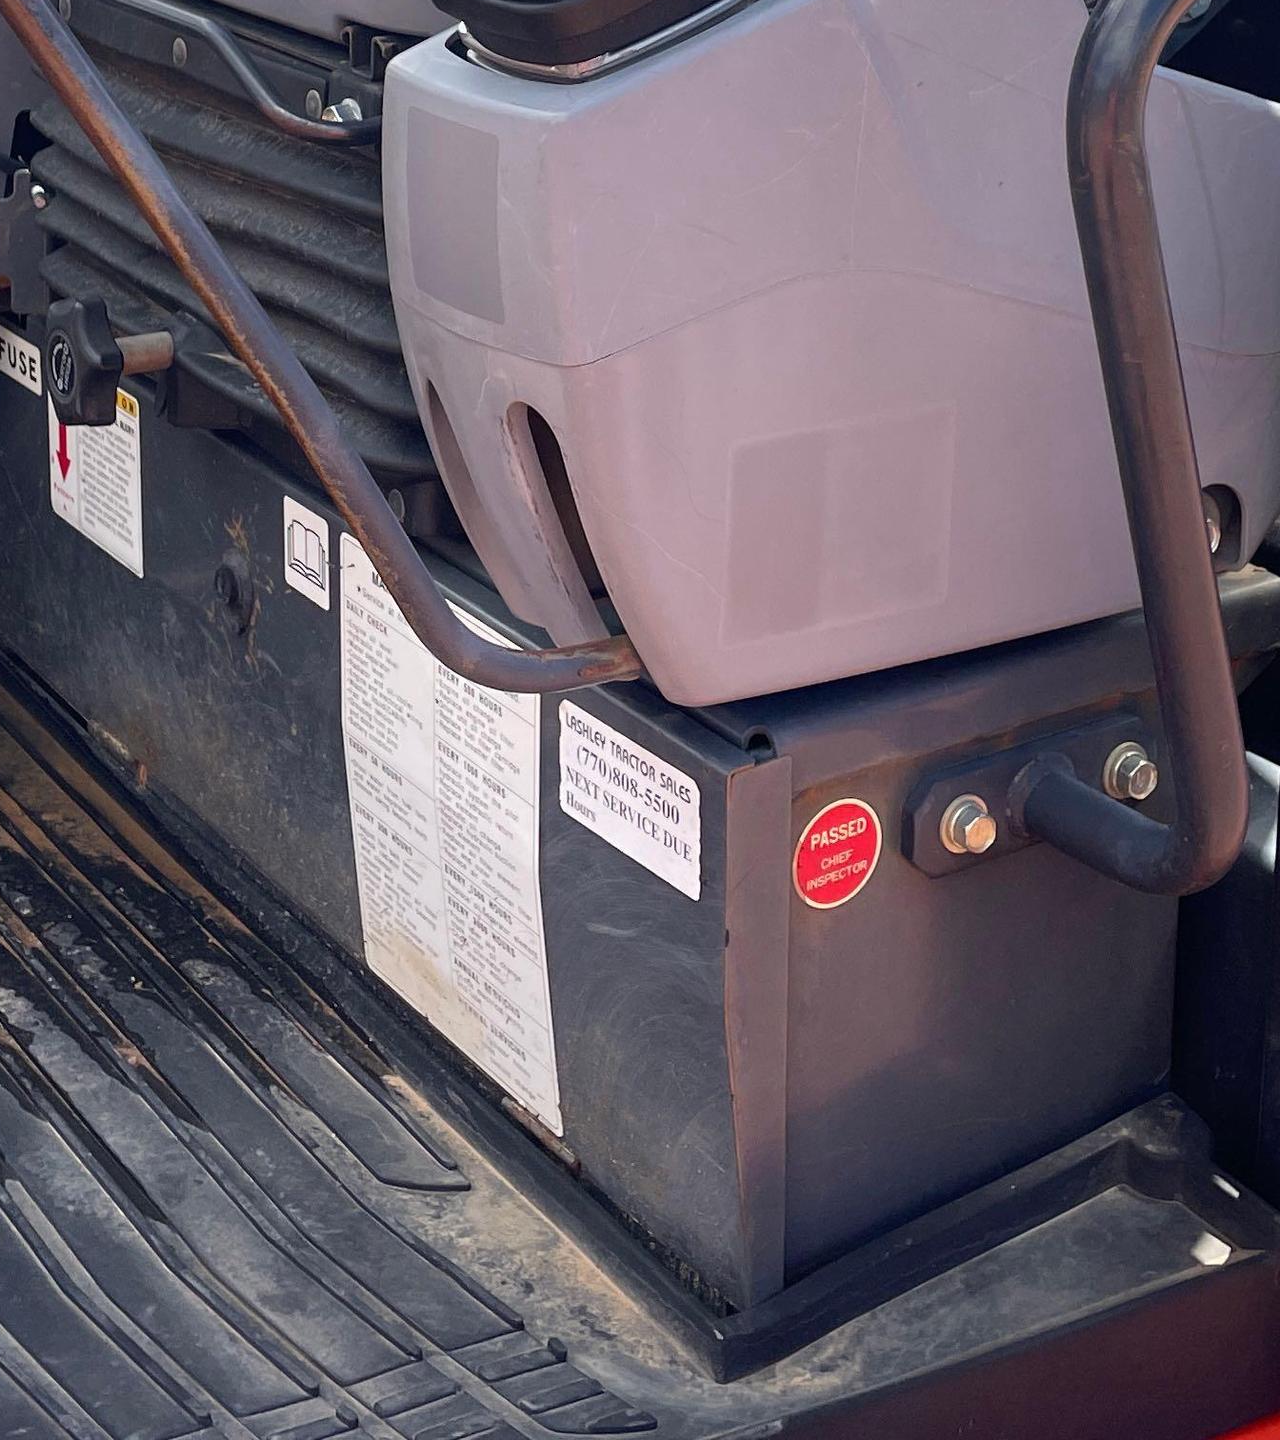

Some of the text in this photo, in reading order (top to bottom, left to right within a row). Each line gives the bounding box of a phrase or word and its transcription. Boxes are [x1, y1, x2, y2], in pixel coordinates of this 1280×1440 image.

[438, 663, 459, 687] EVERY
[438, 740, 459, 764] EVERY
[565, 711, 606, 749] LASHLEY
[610, 740, 656, 783] TRACTOR
[660, 772, 691, 804] SALES
[576, 744, 680, 825] (770)808-5500
[566, 790, 597, 823] Hours
[566, 765, 693, 862] NEXT SERVICE DUE
[810, 817, 867, 851] PASSED
[806, 859, 868, 891] INSPECTOR
[820, 848, 855, 870] CHIEF
